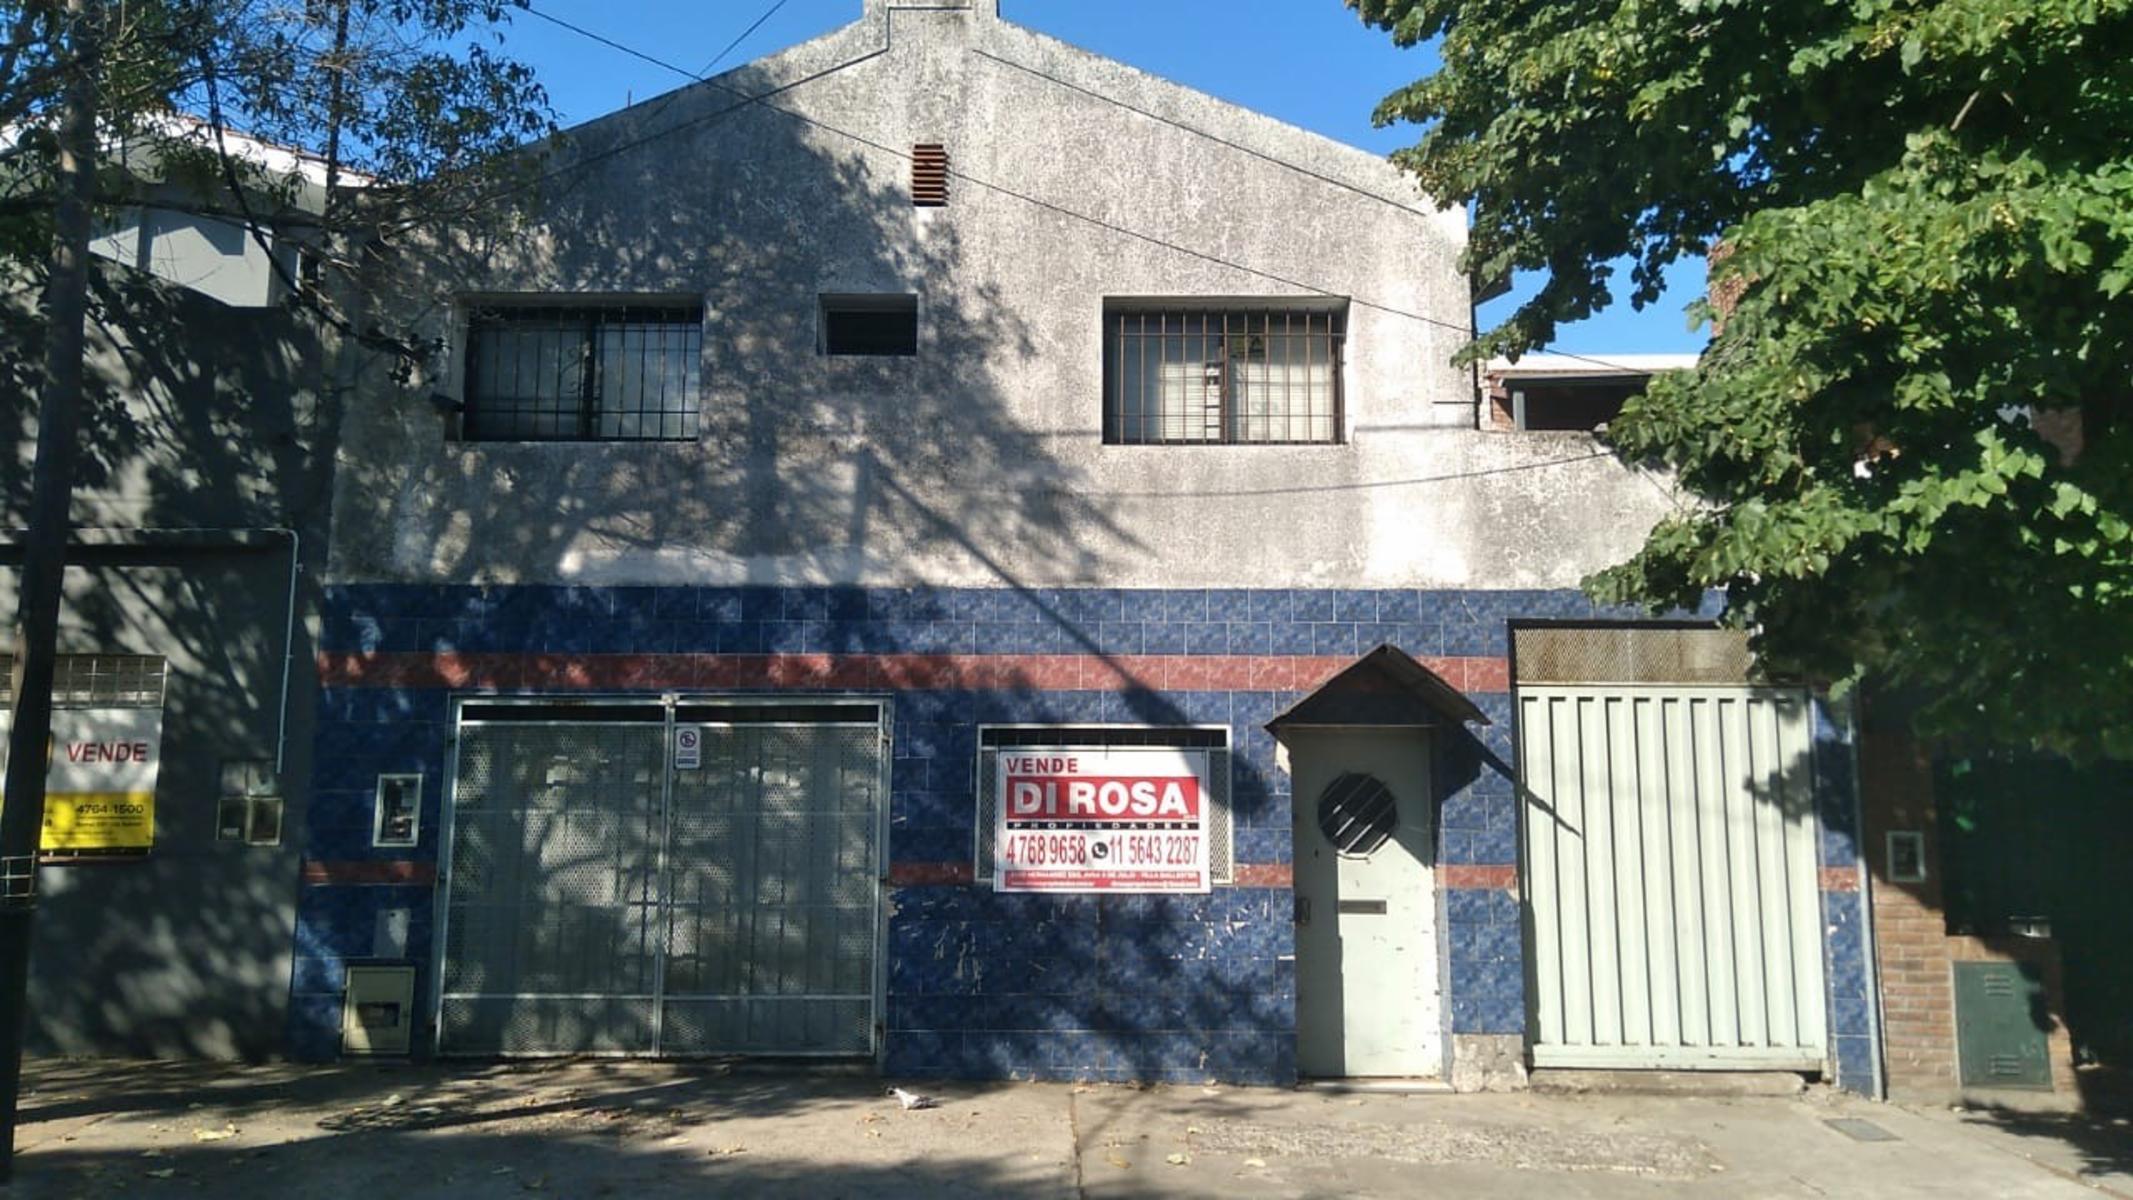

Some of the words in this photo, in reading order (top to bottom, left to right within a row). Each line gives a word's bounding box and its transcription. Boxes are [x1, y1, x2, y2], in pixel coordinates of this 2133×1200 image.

[67, 743, 148, 762] VENDE
[1006, 757, 1079, 773] VENDE
[1013, 781, 1057, 815] DI
[1068, 780, 1189, 815] ROSA
[1006, 836, 1046, 864] 4768
[1050, 836, 1087, 864] 9658
[1110, 836, 1123, 864] 11
[1129, 836, 1162, 864] 5643
[1167, 836, 1200, 864] 2287
